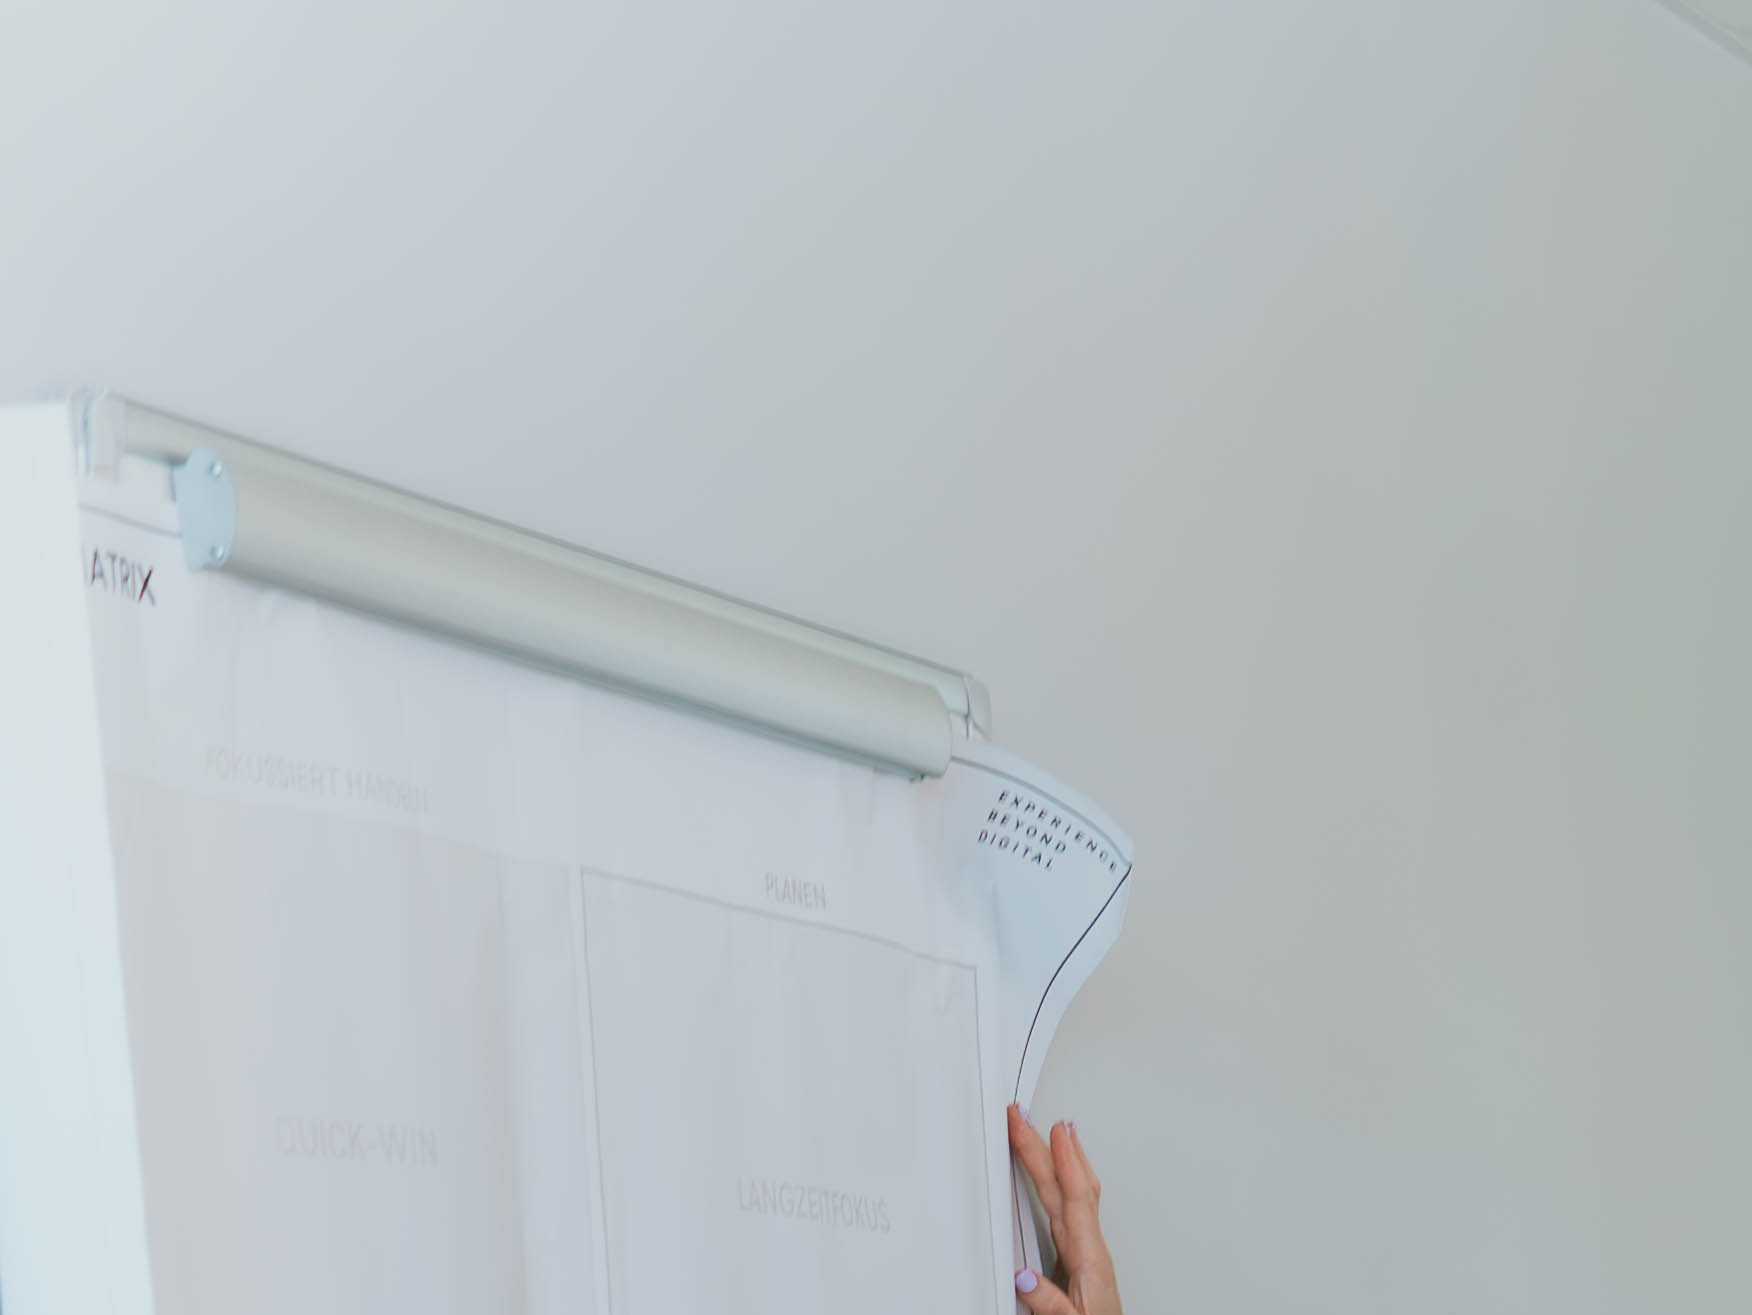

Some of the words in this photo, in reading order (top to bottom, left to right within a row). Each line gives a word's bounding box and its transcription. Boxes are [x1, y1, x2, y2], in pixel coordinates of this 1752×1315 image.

[82, 546, 155, 606] ATRIX
[977, 829, 1055, 872] DIGITAL
[986, 808, 1067, 853] BEYOND
[998, 789, 1118, 872] EXPERIENCE
